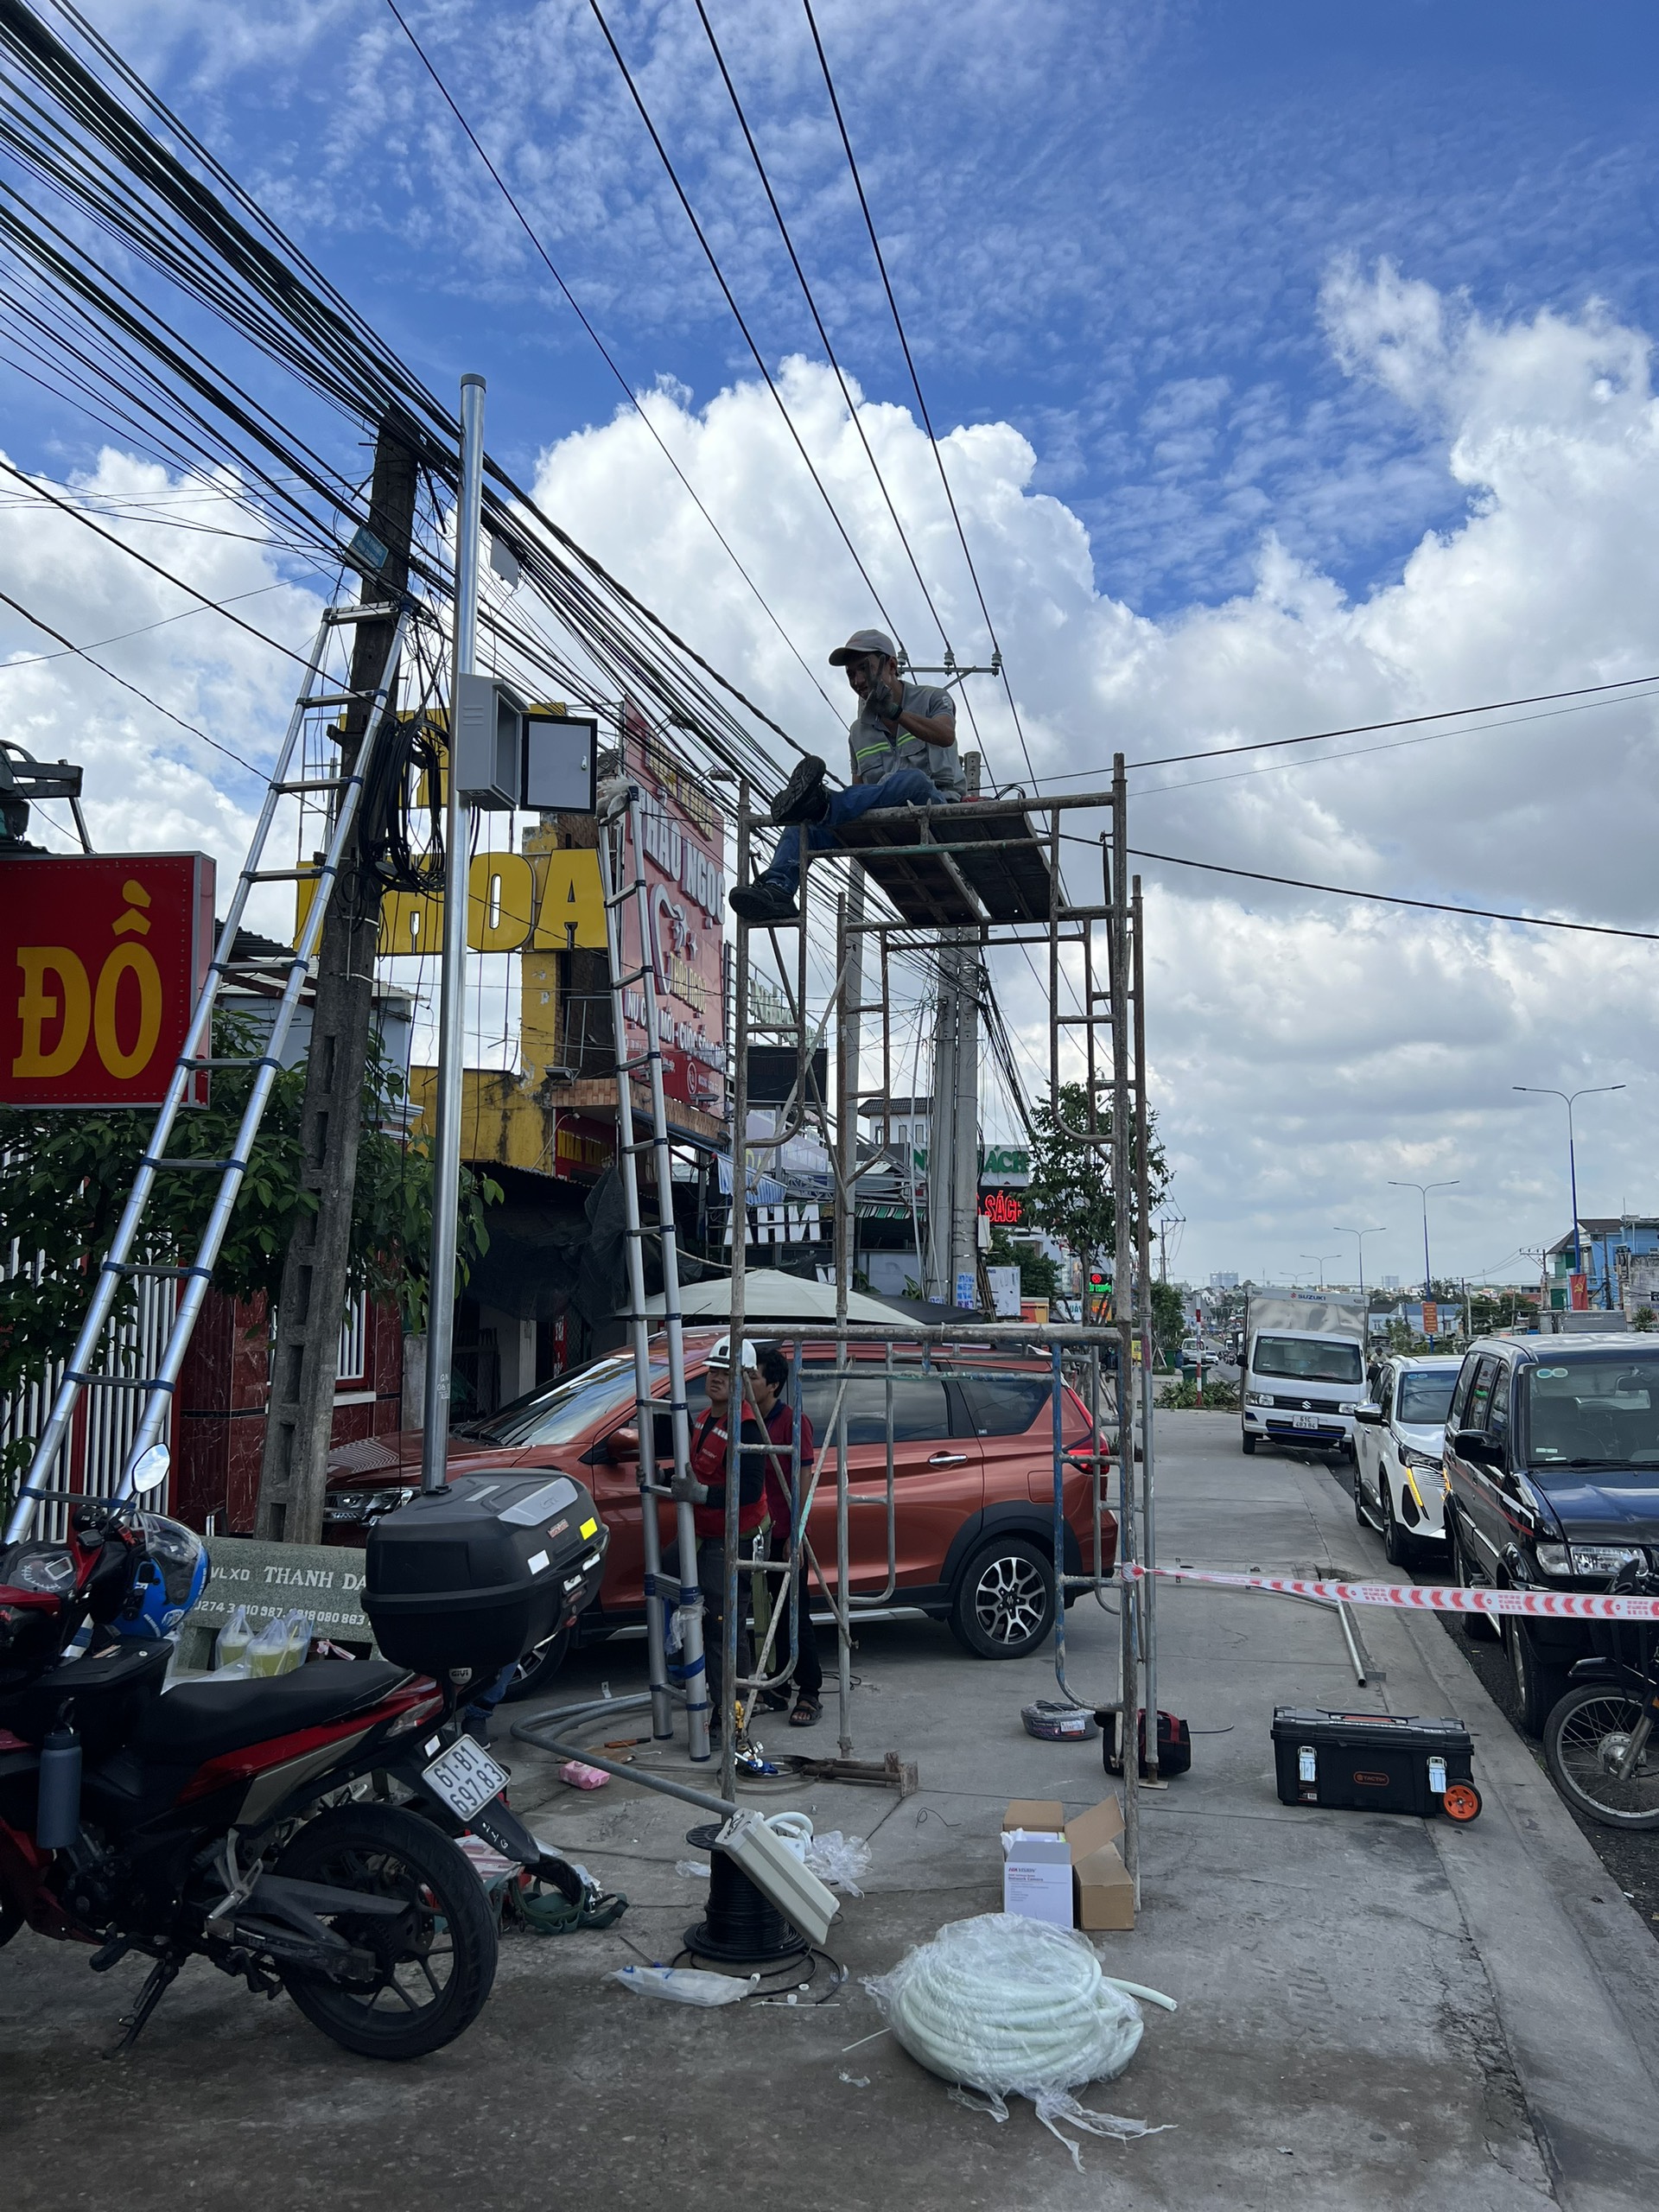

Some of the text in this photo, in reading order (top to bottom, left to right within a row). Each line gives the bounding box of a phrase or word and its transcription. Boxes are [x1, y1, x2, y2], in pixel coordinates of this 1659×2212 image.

[683, 836, 726, 931] NGỌC
[12, 879, 162, 1080] ĐỒ
[210, 1566, 251, 1581] VLXD
[264, 1565, 334, 1588] THANH
[450, 1669, 469, 1678] GIVI
[434, 1745, 480, 1789] 61-B1
[449, 1763, 503, 1814] 697.83
